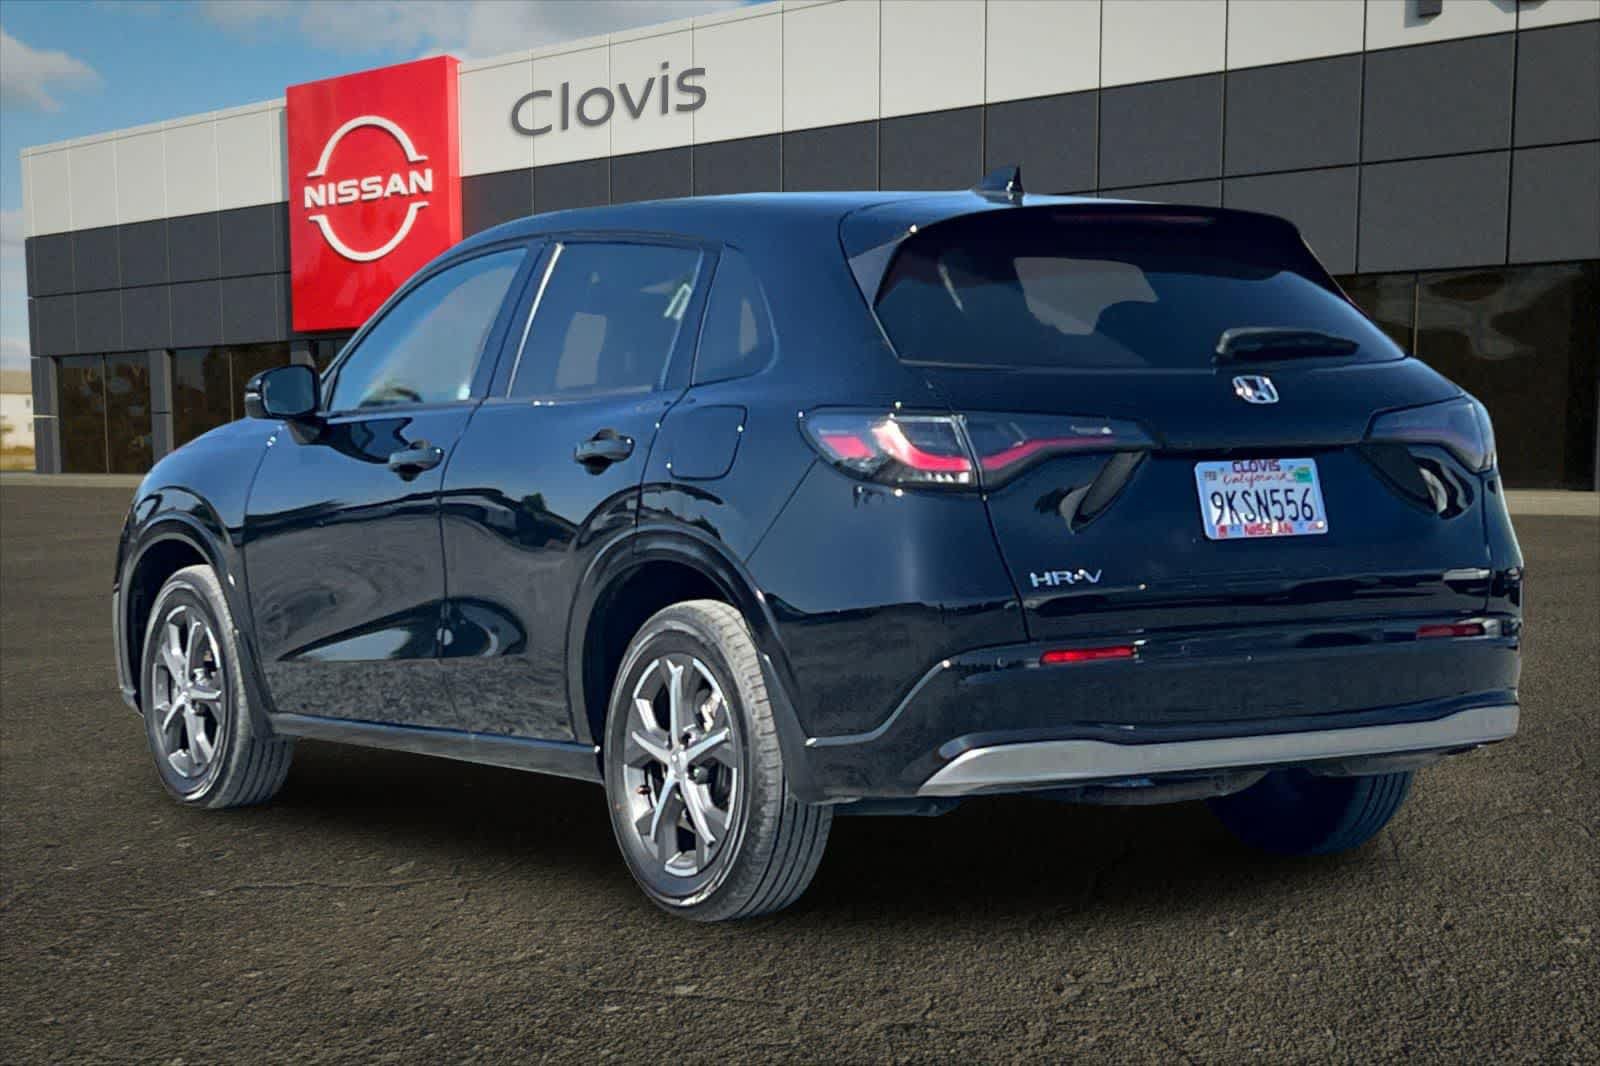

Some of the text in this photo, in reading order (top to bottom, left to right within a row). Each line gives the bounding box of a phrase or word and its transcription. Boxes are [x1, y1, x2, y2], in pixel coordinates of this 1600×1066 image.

[511, 61, 707, 136] Clovis
[303, 168, 433, 208] NISSAN
[1232, 459, 1281, 473] CLOVIS
[1210, 487, 1314, 526] 9KSN556
